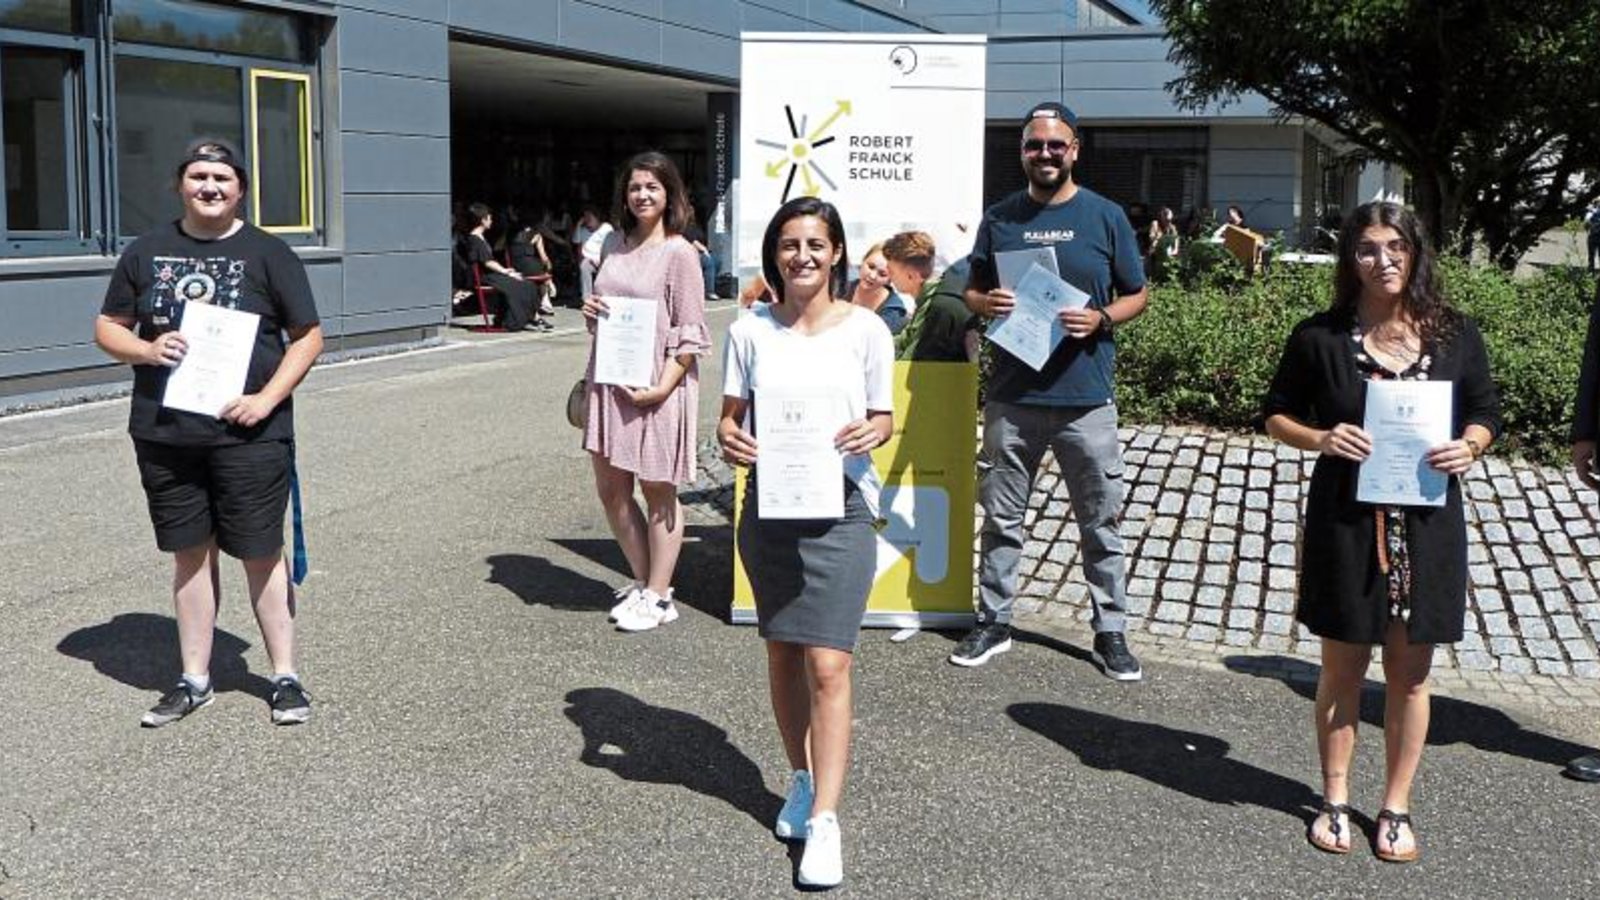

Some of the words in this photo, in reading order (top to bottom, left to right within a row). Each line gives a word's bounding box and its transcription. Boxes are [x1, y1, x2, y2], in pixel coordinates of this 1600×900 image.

[849, 135, 914, 148] ROBERT
[849, 151, 914, 164] FRANCK
[849, 167, 913, 181] SCHULE
